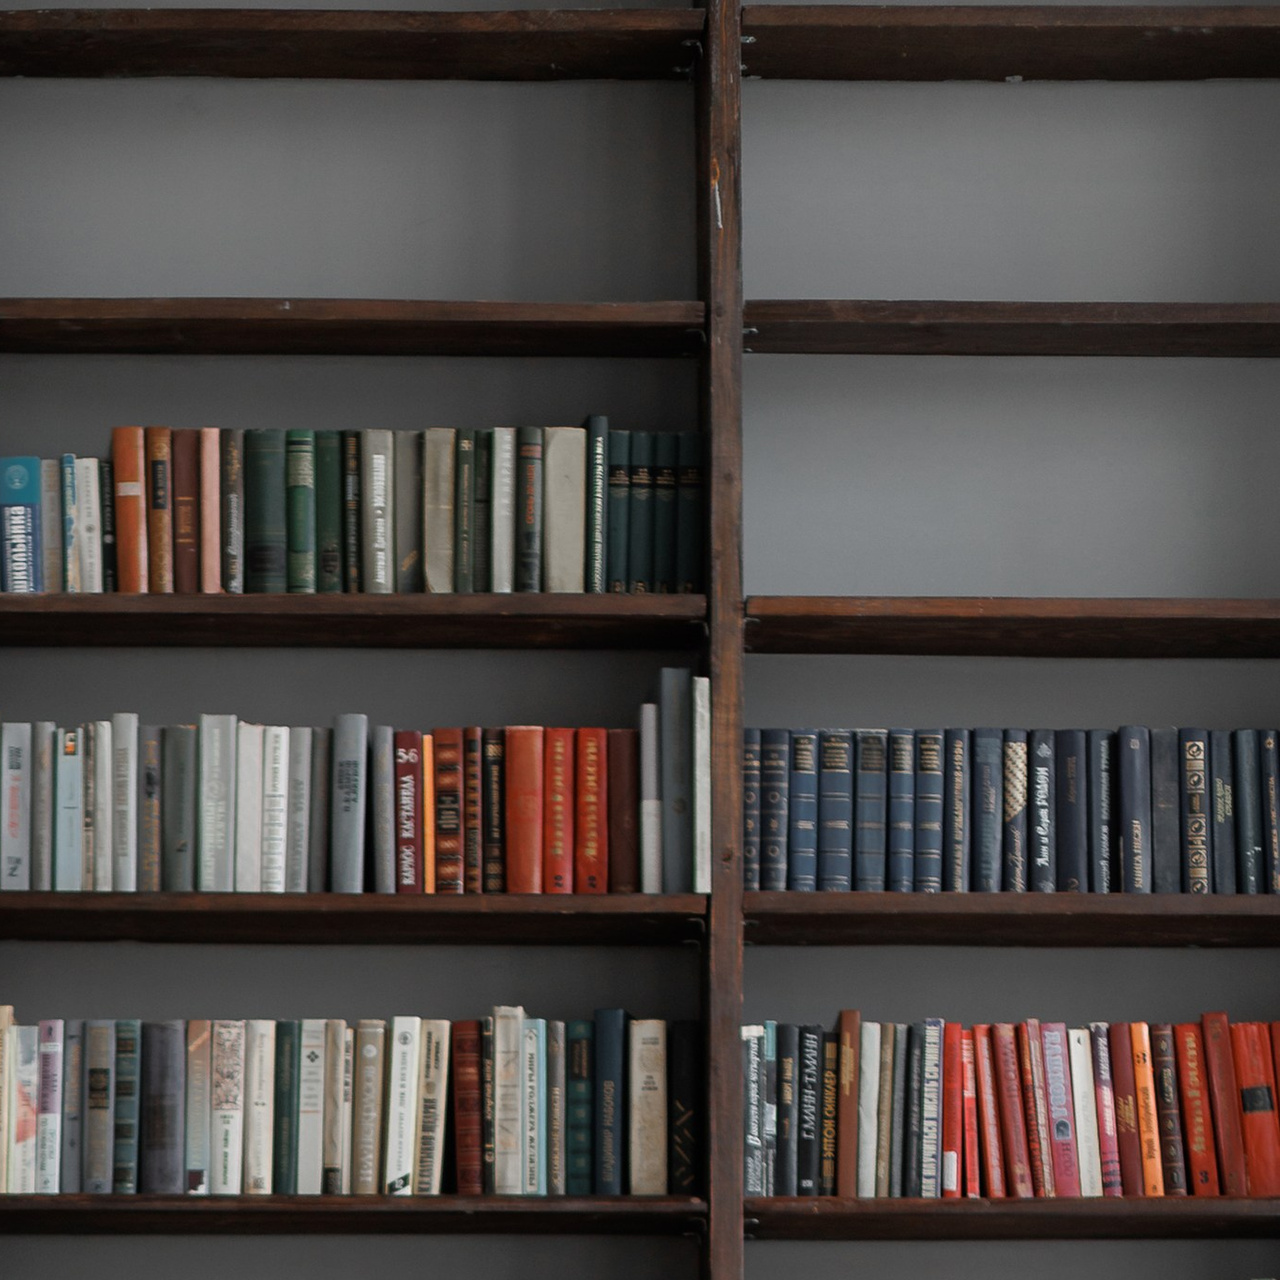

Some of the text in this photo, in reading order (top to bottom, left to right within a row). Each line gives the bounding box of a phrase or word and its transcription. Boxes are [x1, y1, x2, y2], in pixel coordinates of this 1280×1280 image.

[400, 774, 415, 885] КАРЛОС КАСТАНЕДА
[603, 1080, 615, 1127] НАБОКОВ
[923, 1082, 938, 1118] ПИСАТЬ
[823, 1118, 836, 1158] ЭПТОН
[923, 1120, 937, 1175] НАУЧИТЬСЯ
[923, 1178, 936, 1198] КАК
